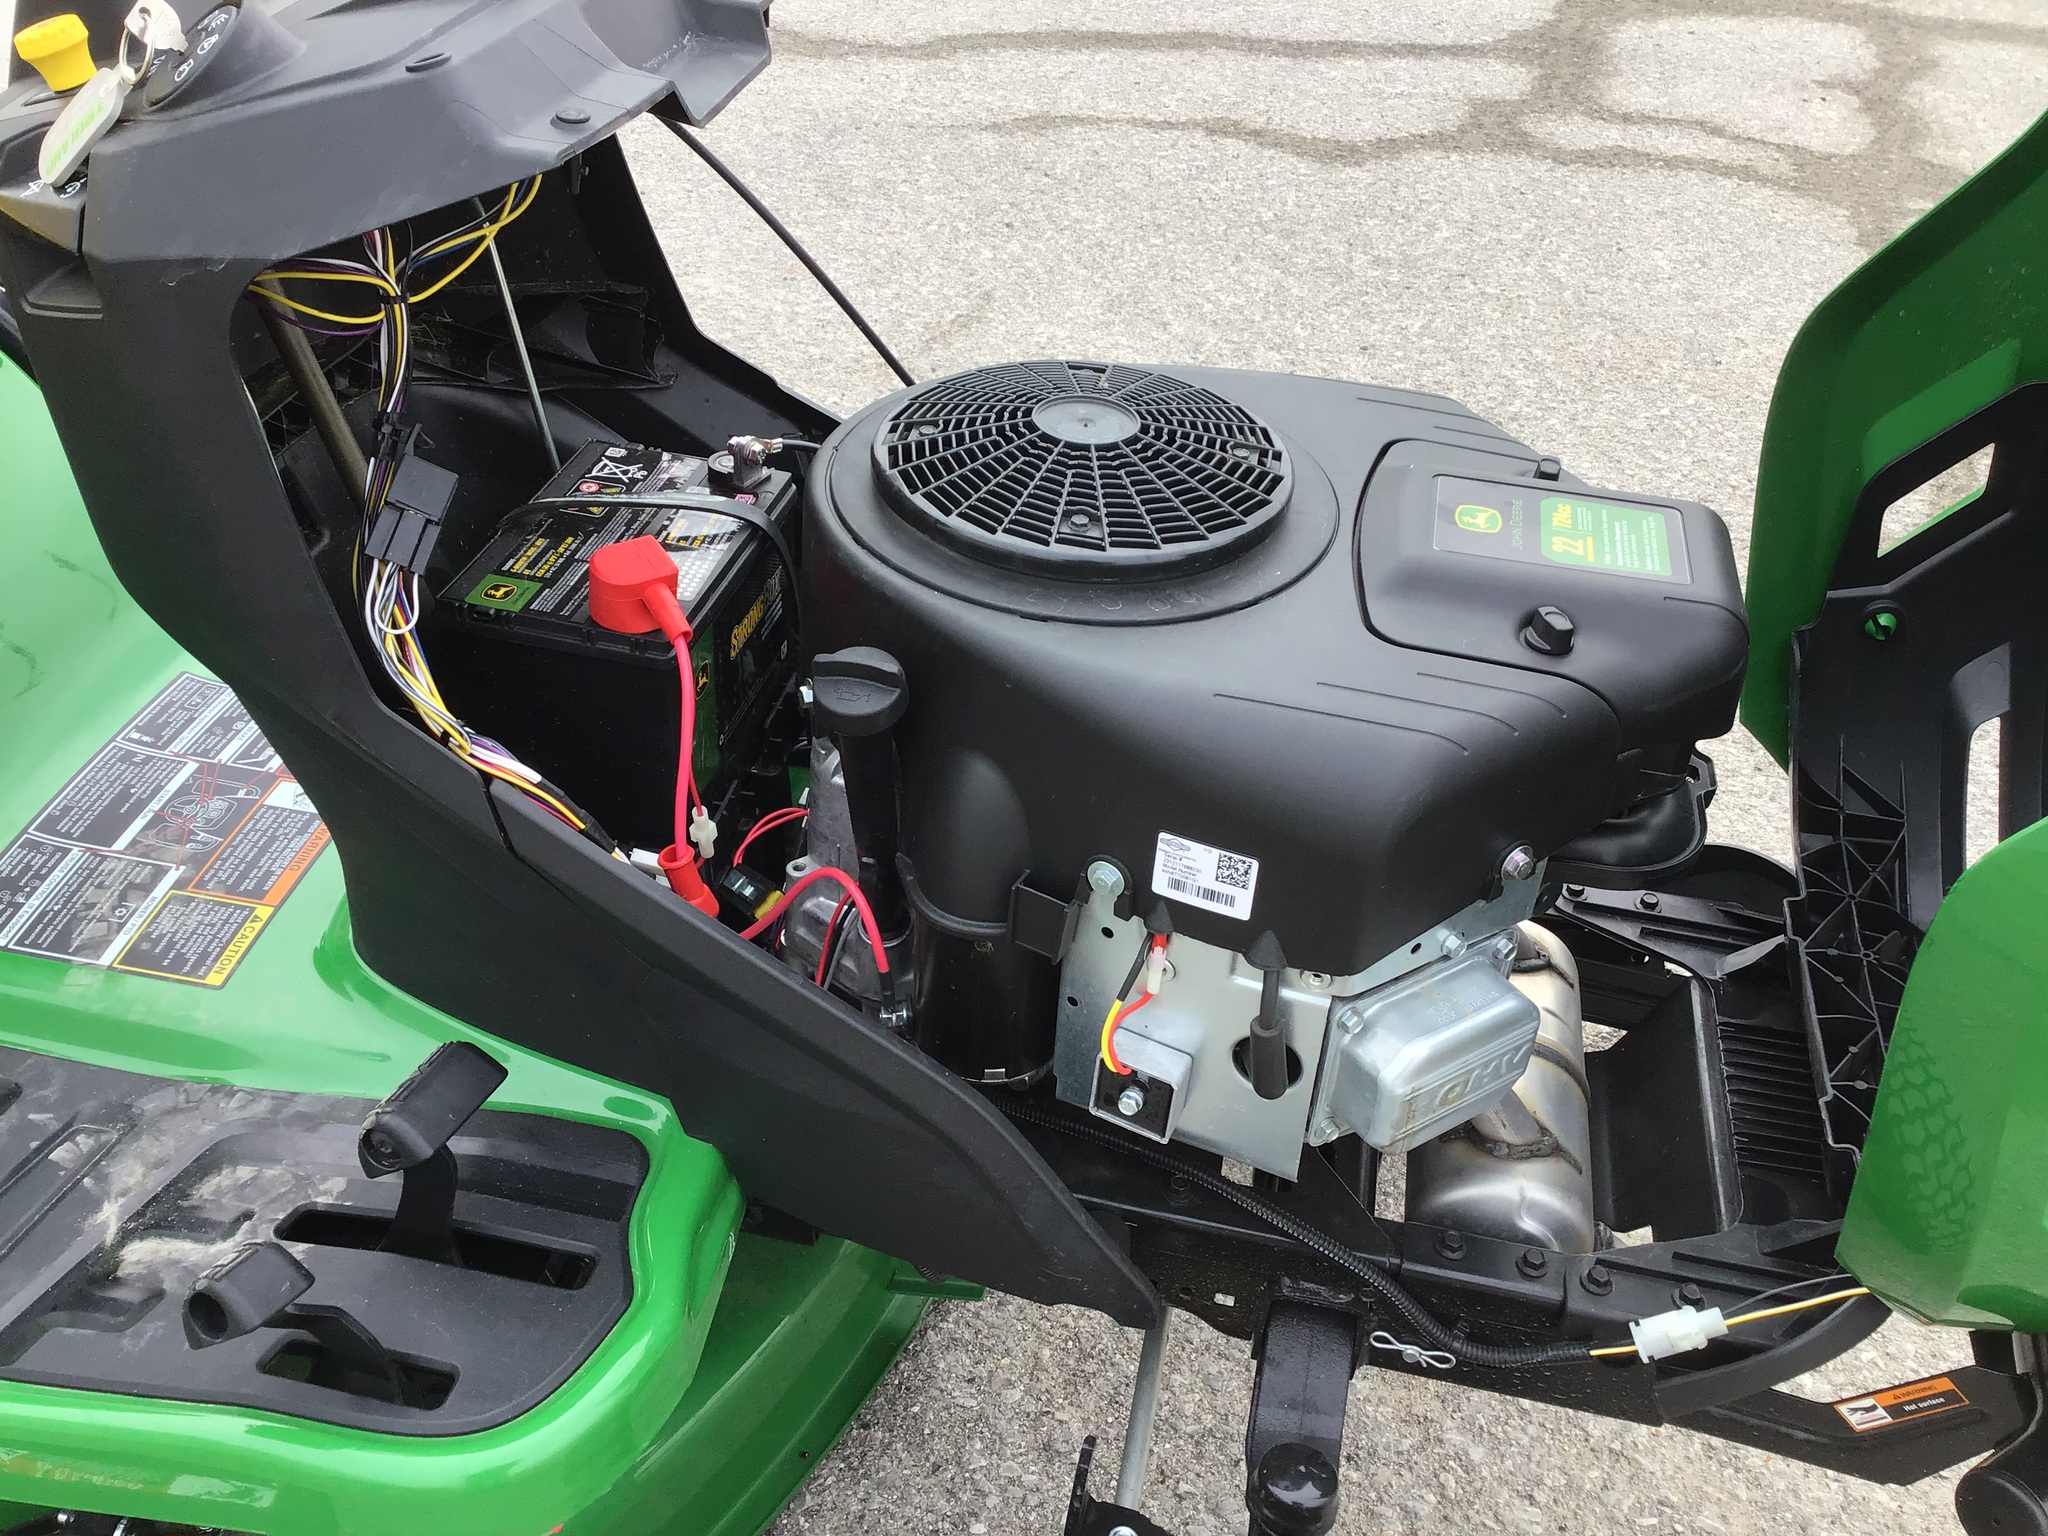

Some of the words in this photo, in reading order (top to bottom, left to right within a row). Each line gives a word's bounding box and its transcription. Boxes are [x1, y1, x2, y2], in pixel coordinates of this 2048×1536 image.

[1510, 499, 1523, 524] DEERE
[288, 826, 329, 872] WARNING
[56, 852, 78, 873] CRUISE
[32, 874, 60, 902] CONTROL
[212, 925, 256, 974] CAUTION
[1901, 1384, 1937, 1398] WARNING
[1903, 1404, 1917, 1412] Hot
[1917, 1397, 1945, 1407] surface
